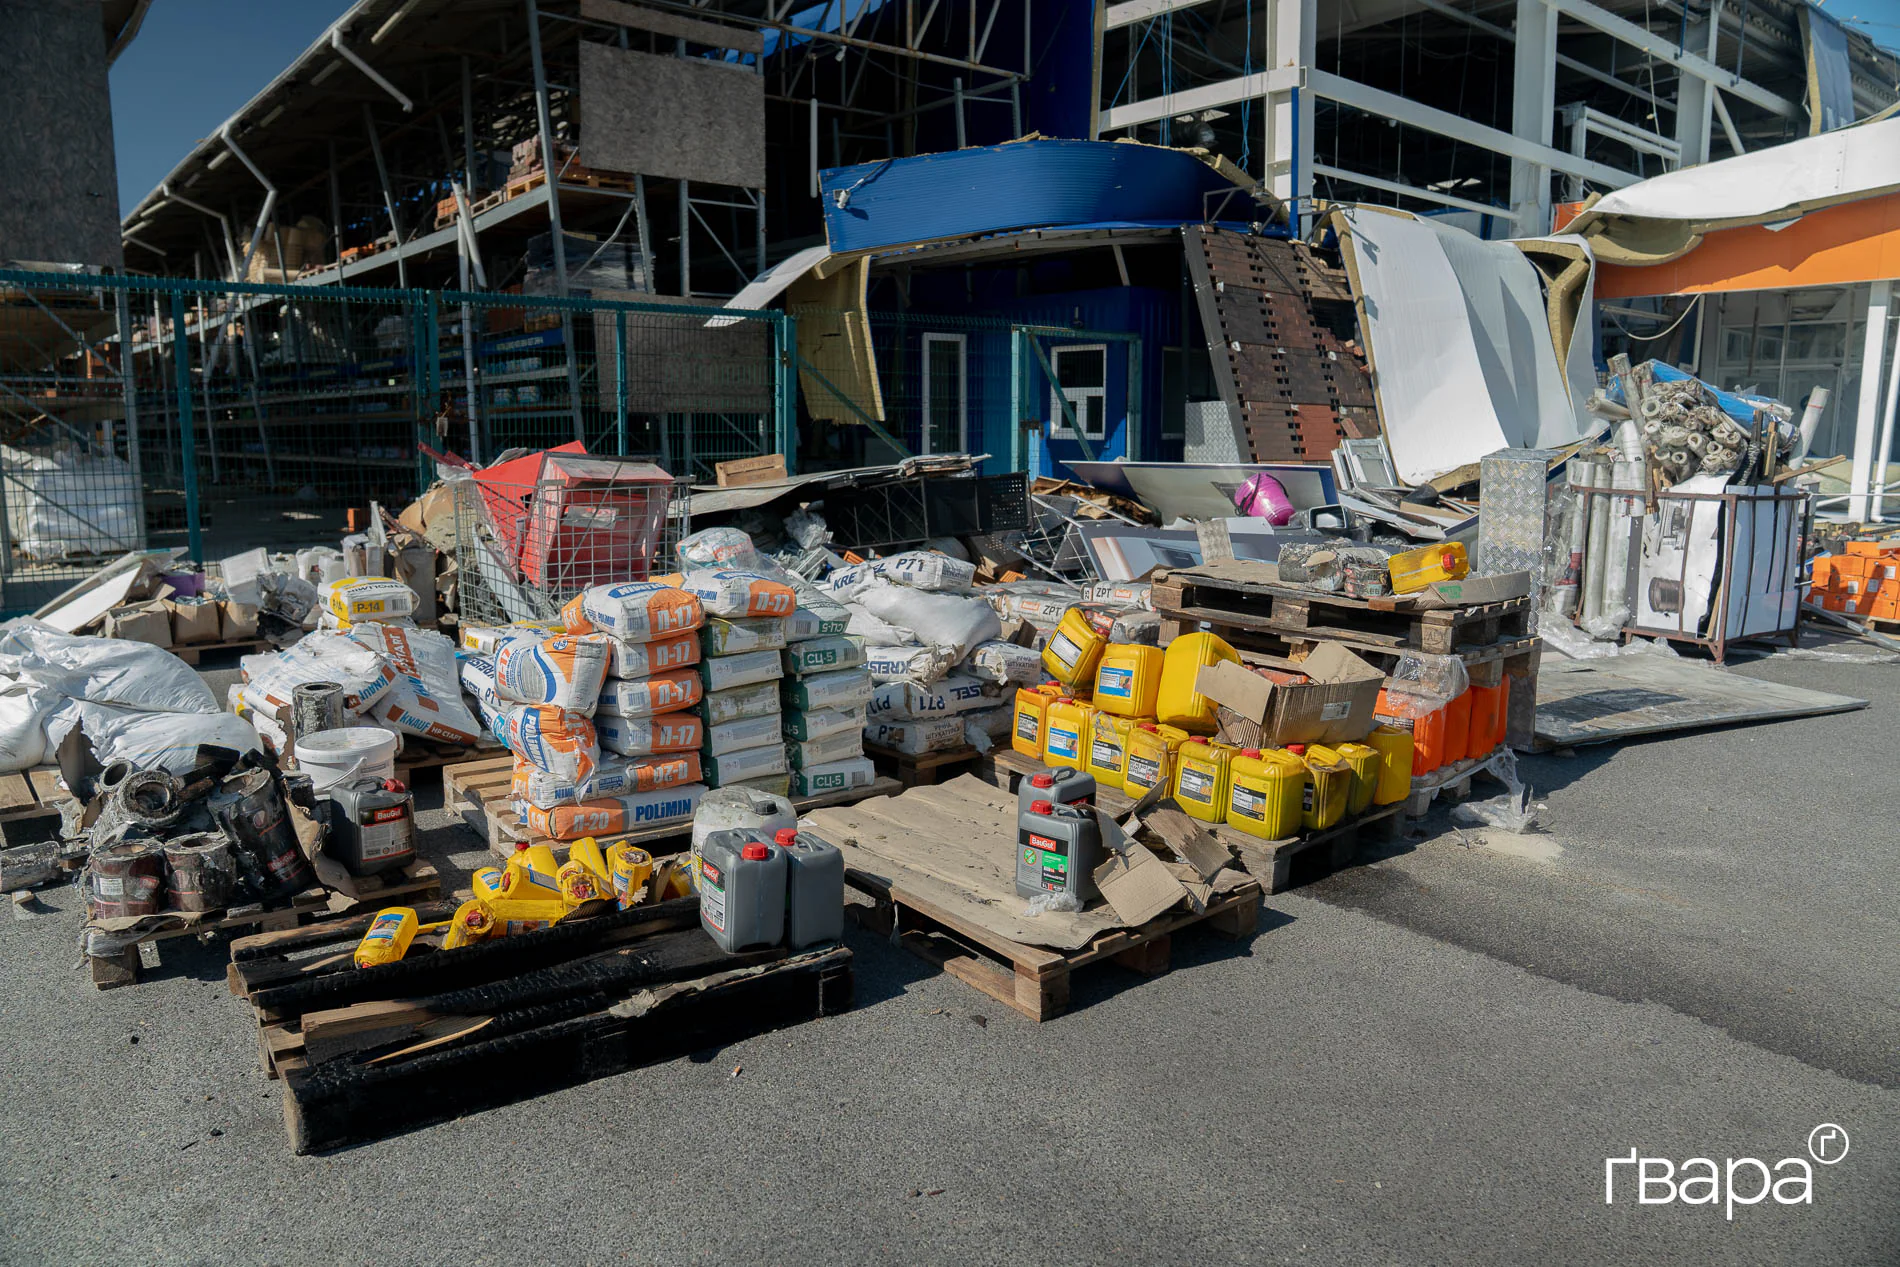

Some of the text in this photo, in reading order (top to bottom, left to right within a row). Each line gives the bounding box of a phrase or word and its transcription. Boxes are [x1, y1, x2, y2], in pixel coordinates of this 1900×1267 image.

[895, 558, 924, 572] P71
[755, 591, 790, 613] П-17
[1095, 587, 1112, 599] ZPT
[357, 602, 381, 613] P-14
[1043, 604, 1062, 617] ZPT
[657, 605, 693, 631] П-17
[656, 641, 691, 667] П-17
[806, 651, 833, 665] СЦ-5
[861, 660, 912, 675] KREIS
[658, 680, 693, 705] П-17
[399, 710, 431, 733] KNAUF
[660, 724, 696, 747] П-17
[653, 761, 689, 785] П-20
[816, 774, 842, 787] СЦ-5
[573, 812, 610, 833] П-20
[1031, 836, 1054, 849] BauGut
